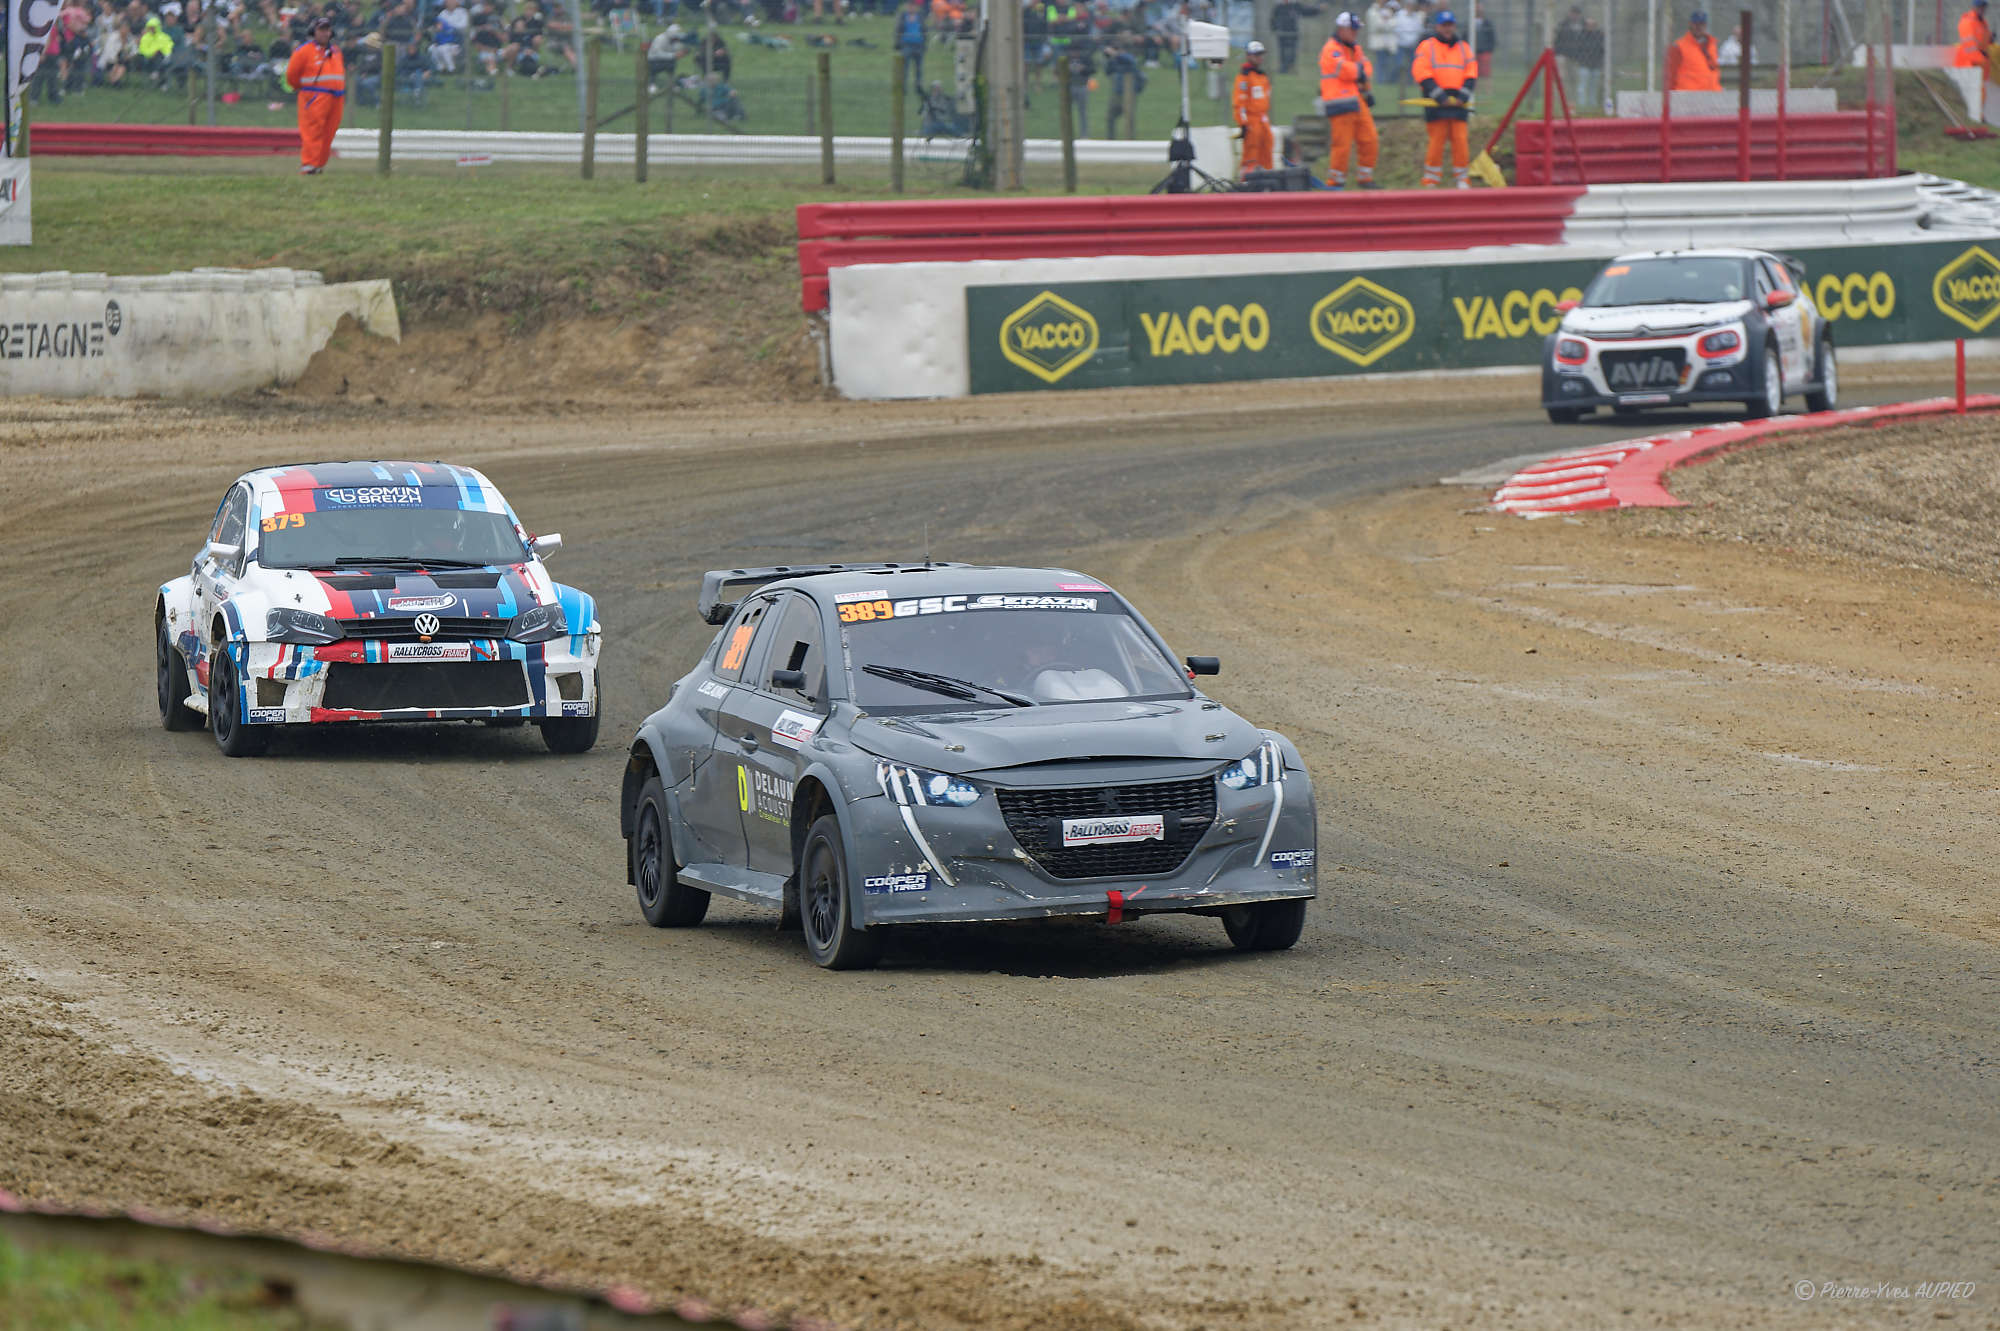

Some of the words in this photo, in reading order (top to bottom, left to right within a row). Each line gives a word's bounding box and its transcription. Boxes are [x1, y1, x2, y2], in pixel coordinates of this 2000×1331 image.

[1801, 271, 1896, 321] CCO
[1326, 306, 1400, 335] YACCO
[1015, 321, 1085, 350] YACCO
[1139, 303, 1270, 357] YACCO
[358, 495, 422, 504] BREIZH
[261, 513, 306, 533] 379
[838, 600, 894, 622] 389
[894, 595, 968, 617] GSC
[968, 595, 1097, 612] SERAZIN
[394, 646, 443, 656] RALLYCROSS
[443, 648, 469, 658] FRANCE
[250, 710, 285, 718] COOPER
[755, 770, 794, 802] DELAUN
[1069, 820, 1130, 837] RALLYCROSS
[1271, 850, 1315, 861] COOPER
[864, 874, 927, 887] COOPER
[893, 882, 926, 892] TIRES
